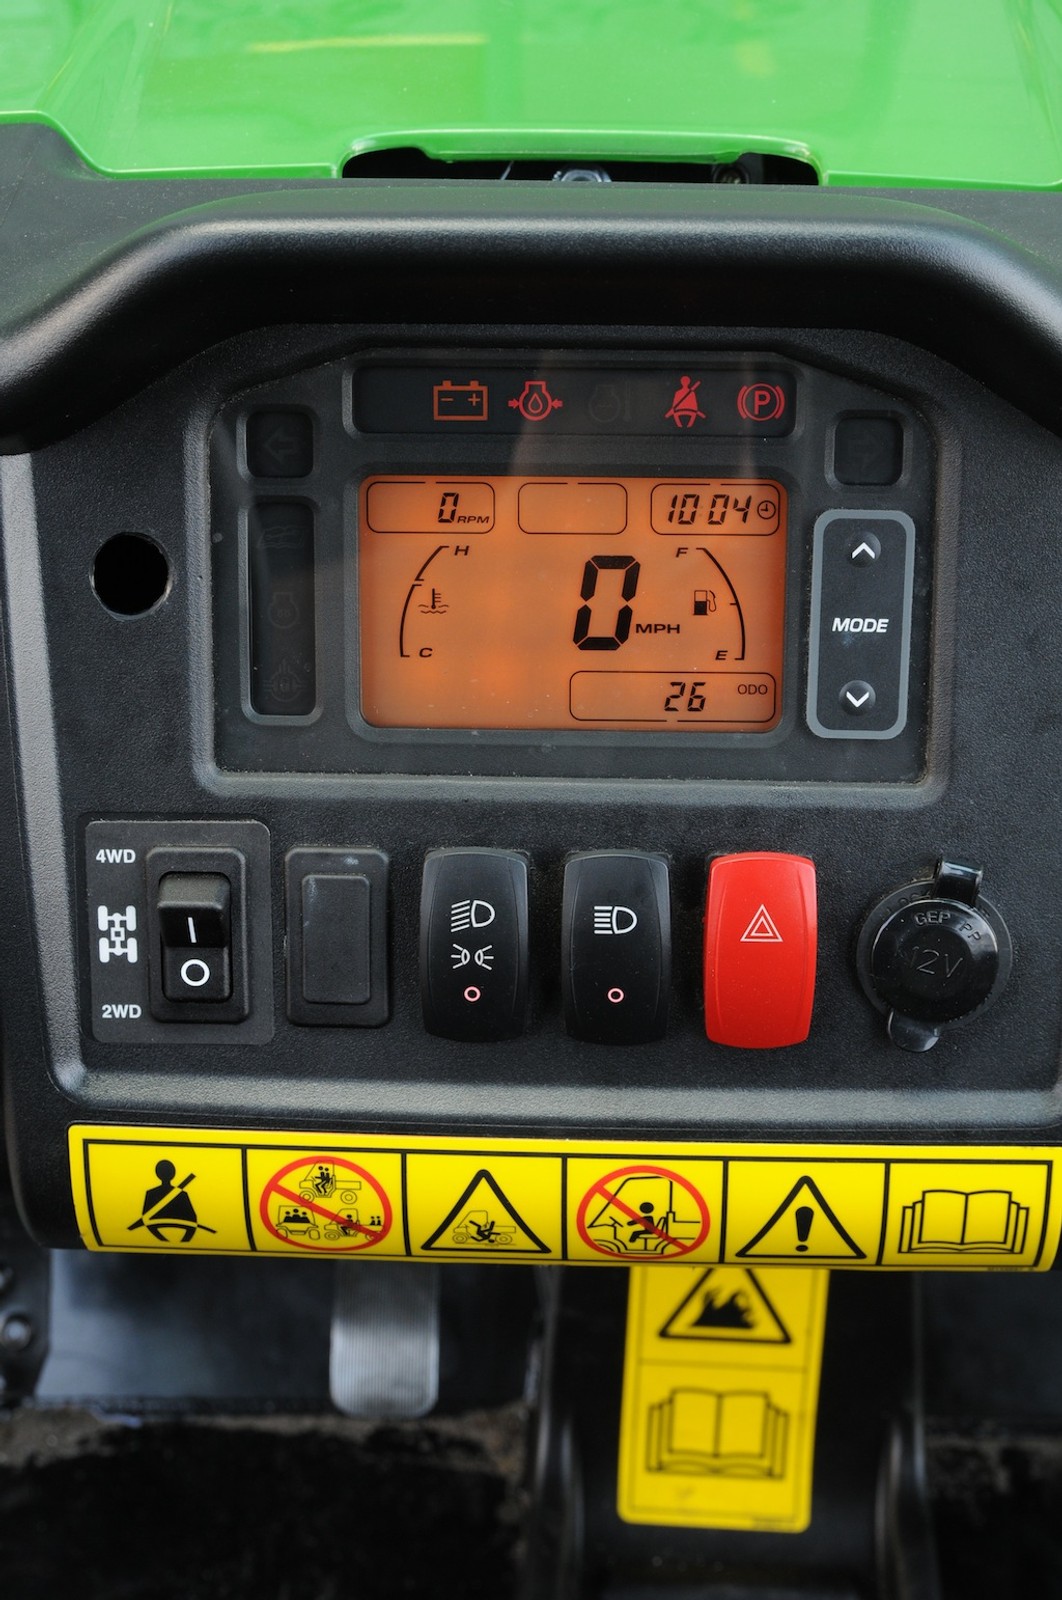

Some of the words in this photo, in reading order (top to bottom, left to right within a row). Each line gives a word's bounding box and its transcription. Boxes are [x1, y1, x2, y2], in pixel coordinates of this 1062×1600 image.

[754, 390, 772, 415] P
[438, 492, 459, 524] 0
[457, 515, 490, 524] RPM
[454, 545, 470, 556] H
[675, 547, 689, 558] F
[573, 555, 640, 651] 0
[635, 623, 681, 634] MPH
[832, 617, 889, 633] MODE
[418, 647, 433, 658] C
[715, 650, 728, 661] E
[664, 682, 706, 712] 26
[737, 683, 768, 695] ODO
[96, 848, 136, 864] 4WD
[101, 1004, 142, 1019] 2WD
